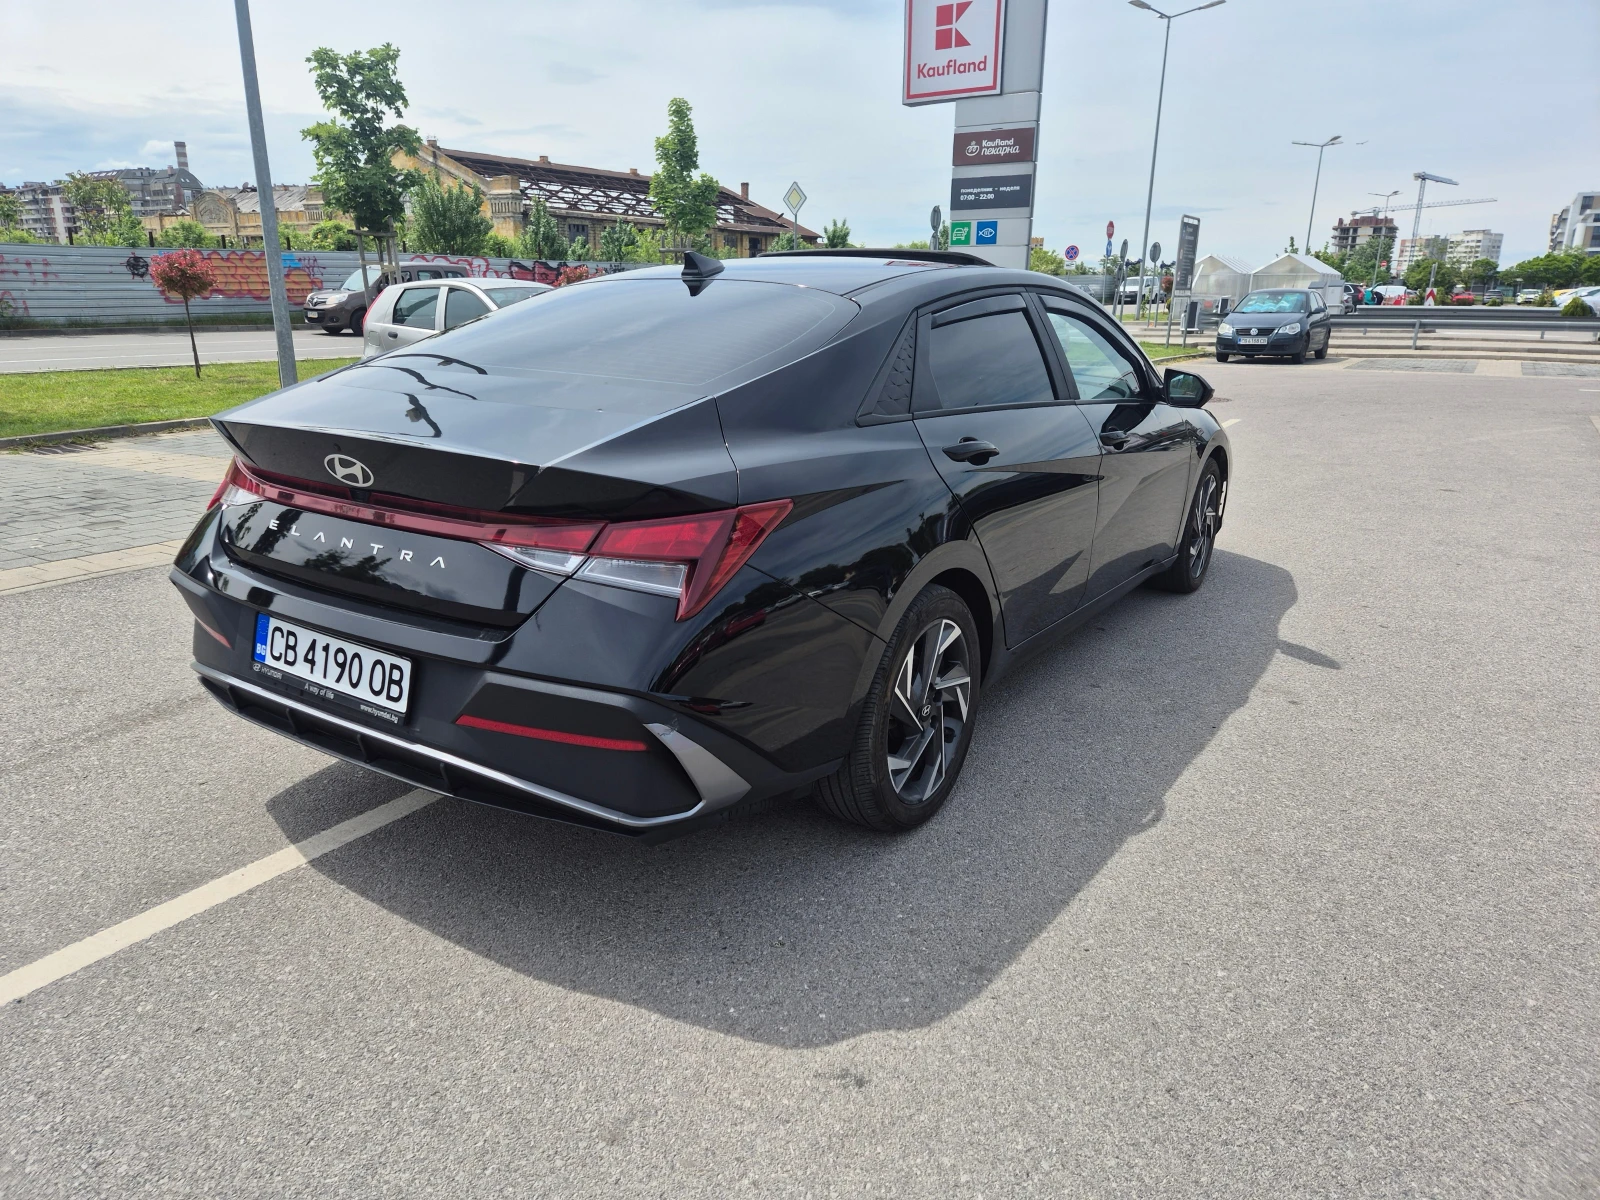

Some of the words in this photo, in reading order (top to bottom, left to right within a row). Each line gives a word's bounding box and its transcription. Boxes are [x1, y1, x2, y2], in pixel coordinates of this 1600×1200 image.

[917, 56, 987, 79] Kaufland
[981, 145, 1020, 156] пекарна
[982, 138, 1014, 148] Kaufland
[268, 519, 446, 569] ELANTRA
[256, 642, 267, 656] BG
[270, 626, 298, 667] CB
[303, 639, 363, 689] 4190
[368, 659, 404, 703] OB
[304, 682, 309, 690] A
[309, 685, 319, 696] way
[319, 687, 326, 696] of
[326, 689, 335, 700] life
